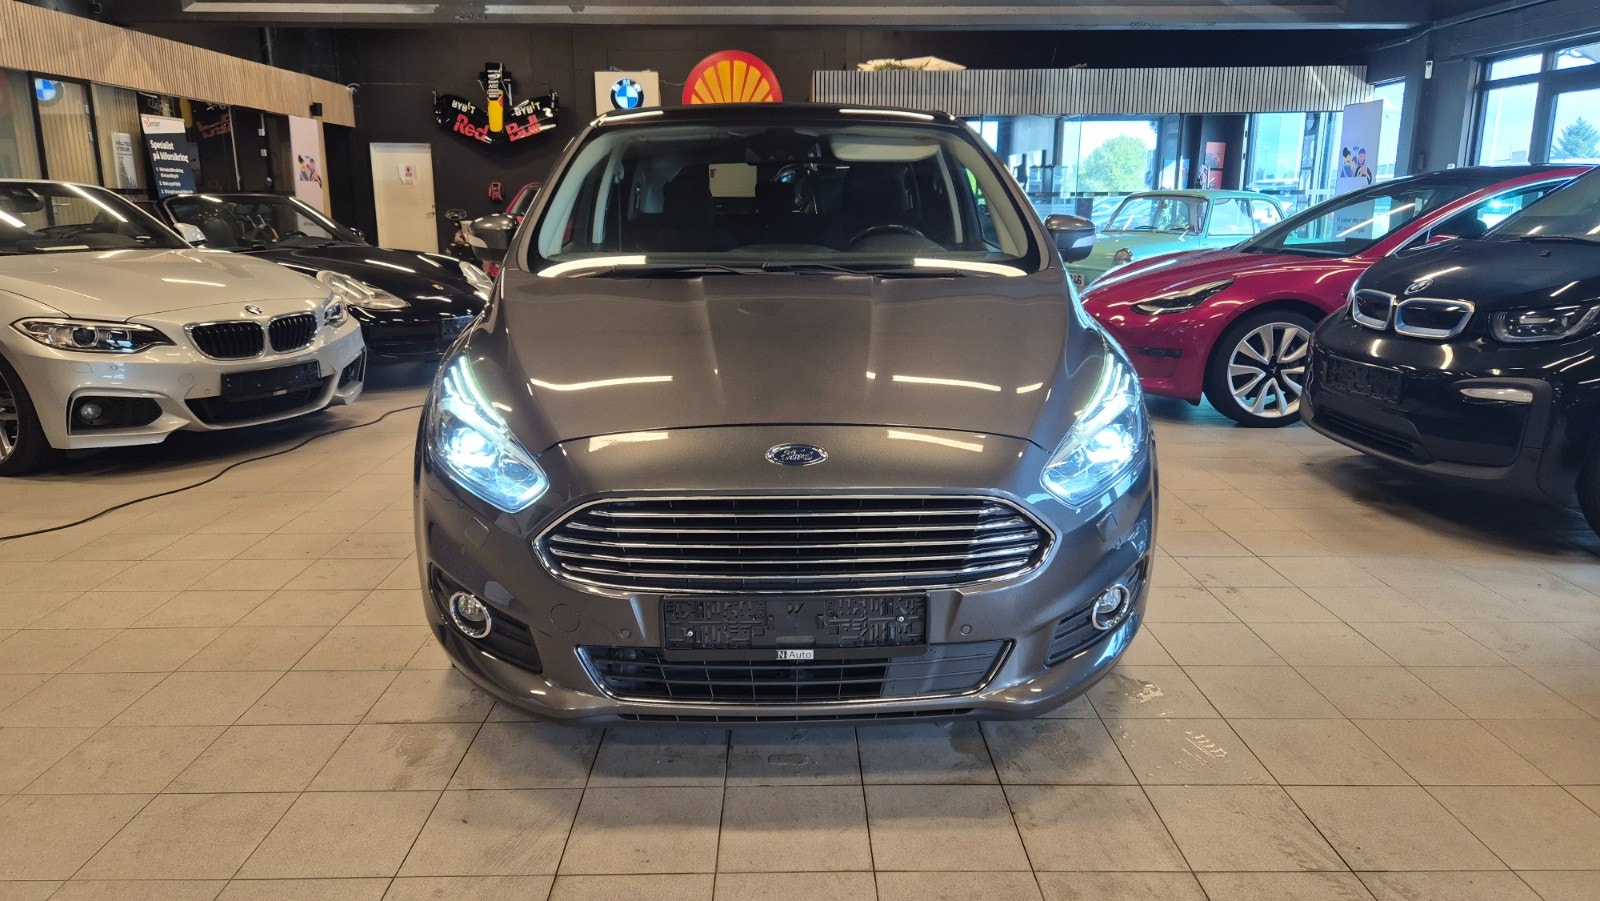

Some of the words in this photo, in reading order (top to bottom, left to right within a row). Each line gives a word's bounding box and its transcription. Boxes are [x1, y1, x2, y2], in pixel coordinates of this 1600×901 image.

[452, 100, 476, 115] BYBIT
[453, 114, 490, 142] Red
[505, 114, 541, 142] Bull
[789, 651, 812, 659] Auto
